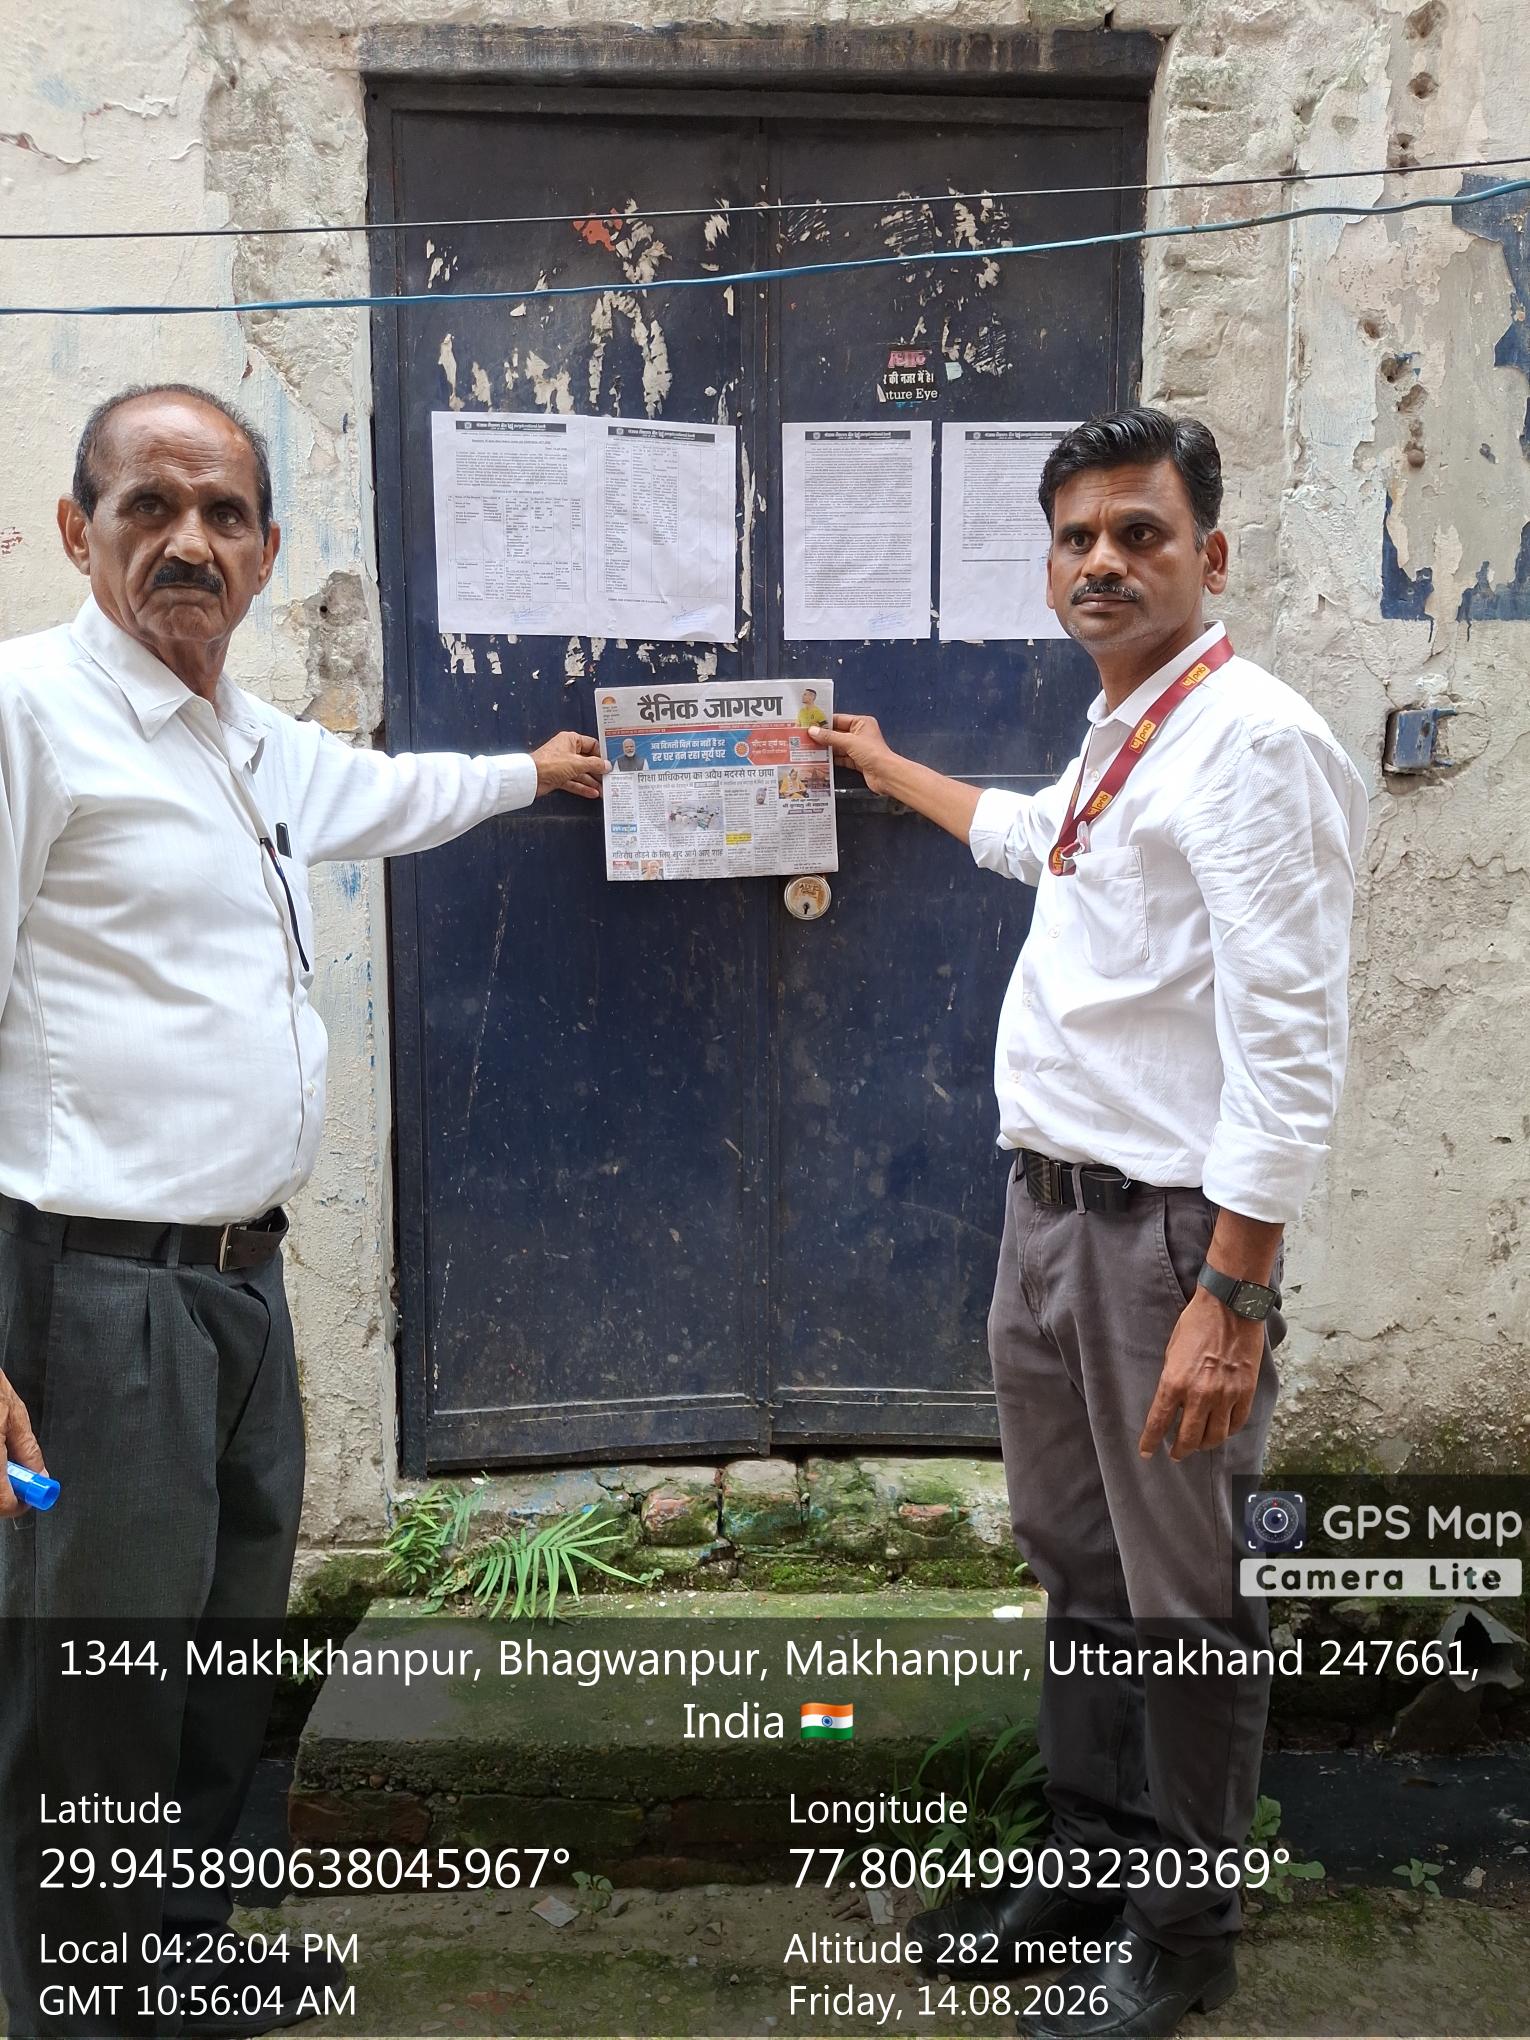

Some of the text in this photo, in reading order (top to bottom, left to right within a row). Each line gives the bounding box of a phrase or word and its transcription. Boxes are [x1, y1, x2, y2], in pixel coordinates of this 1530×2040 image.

[916, 388, 938, 401] Eye
[1192, 666, 1206, 680] pnb
[637, 693, 698, 723] दैनिक
[703, 696, 783, 719] जागरण
[1140, 722, 1152, 738] pnb
[638, 772, 656, 783] शिक्षा
[658, 771, 690, 782] प्राधिकरण
[693, 772, 702, 780] का
[704, 769, 722, 779] अवैध
[724, 768, 745, 778] मदरसे
[748, 769, 756, 777] पर
[1096, 794, 1109, 810] pnb
